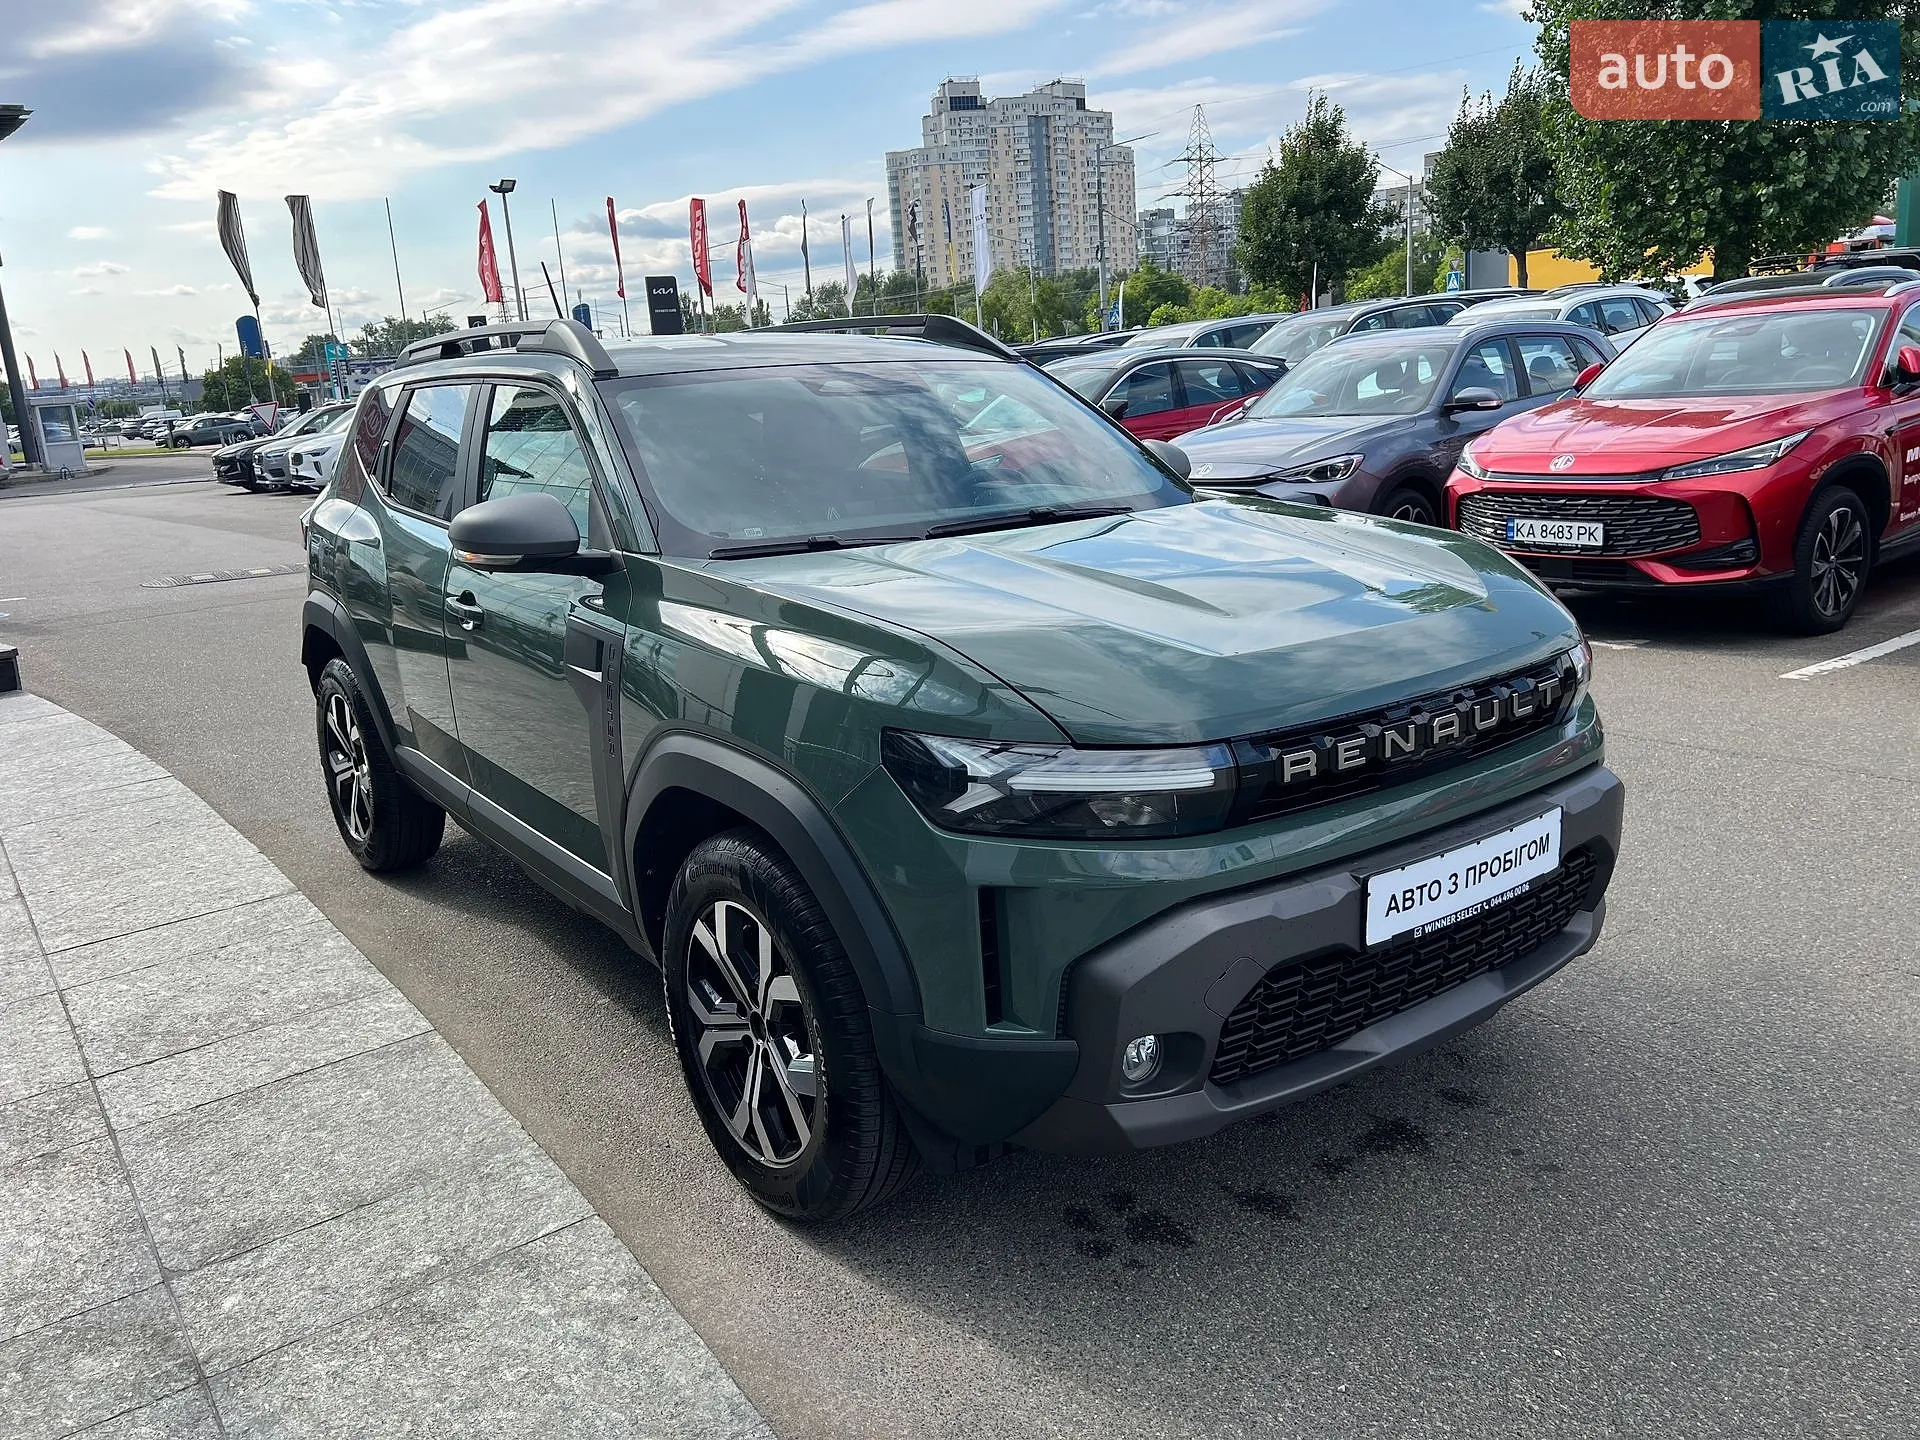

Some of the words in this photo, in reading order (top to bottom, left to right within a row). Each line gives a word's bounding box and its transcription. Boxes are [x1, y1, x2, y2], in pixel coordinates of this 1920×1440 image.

[1516, 522, 1536, 538] KA
[1540, 524, 1573, 540] 8483
[1577, 526, 1599, 542] PK
[606, 643, 616, 758] DUSTER
[1282, 677, 1559, 783] RENAULT
[689, 862, 728, 882] Continental
[1385, 879, 1442, 917] АВТО
[1465, 833, 1551, 888] ПРОБІГОМ
[1424, 915, 1457, 934] WINNER
[1457, 903, 1483, 921] SELECT
